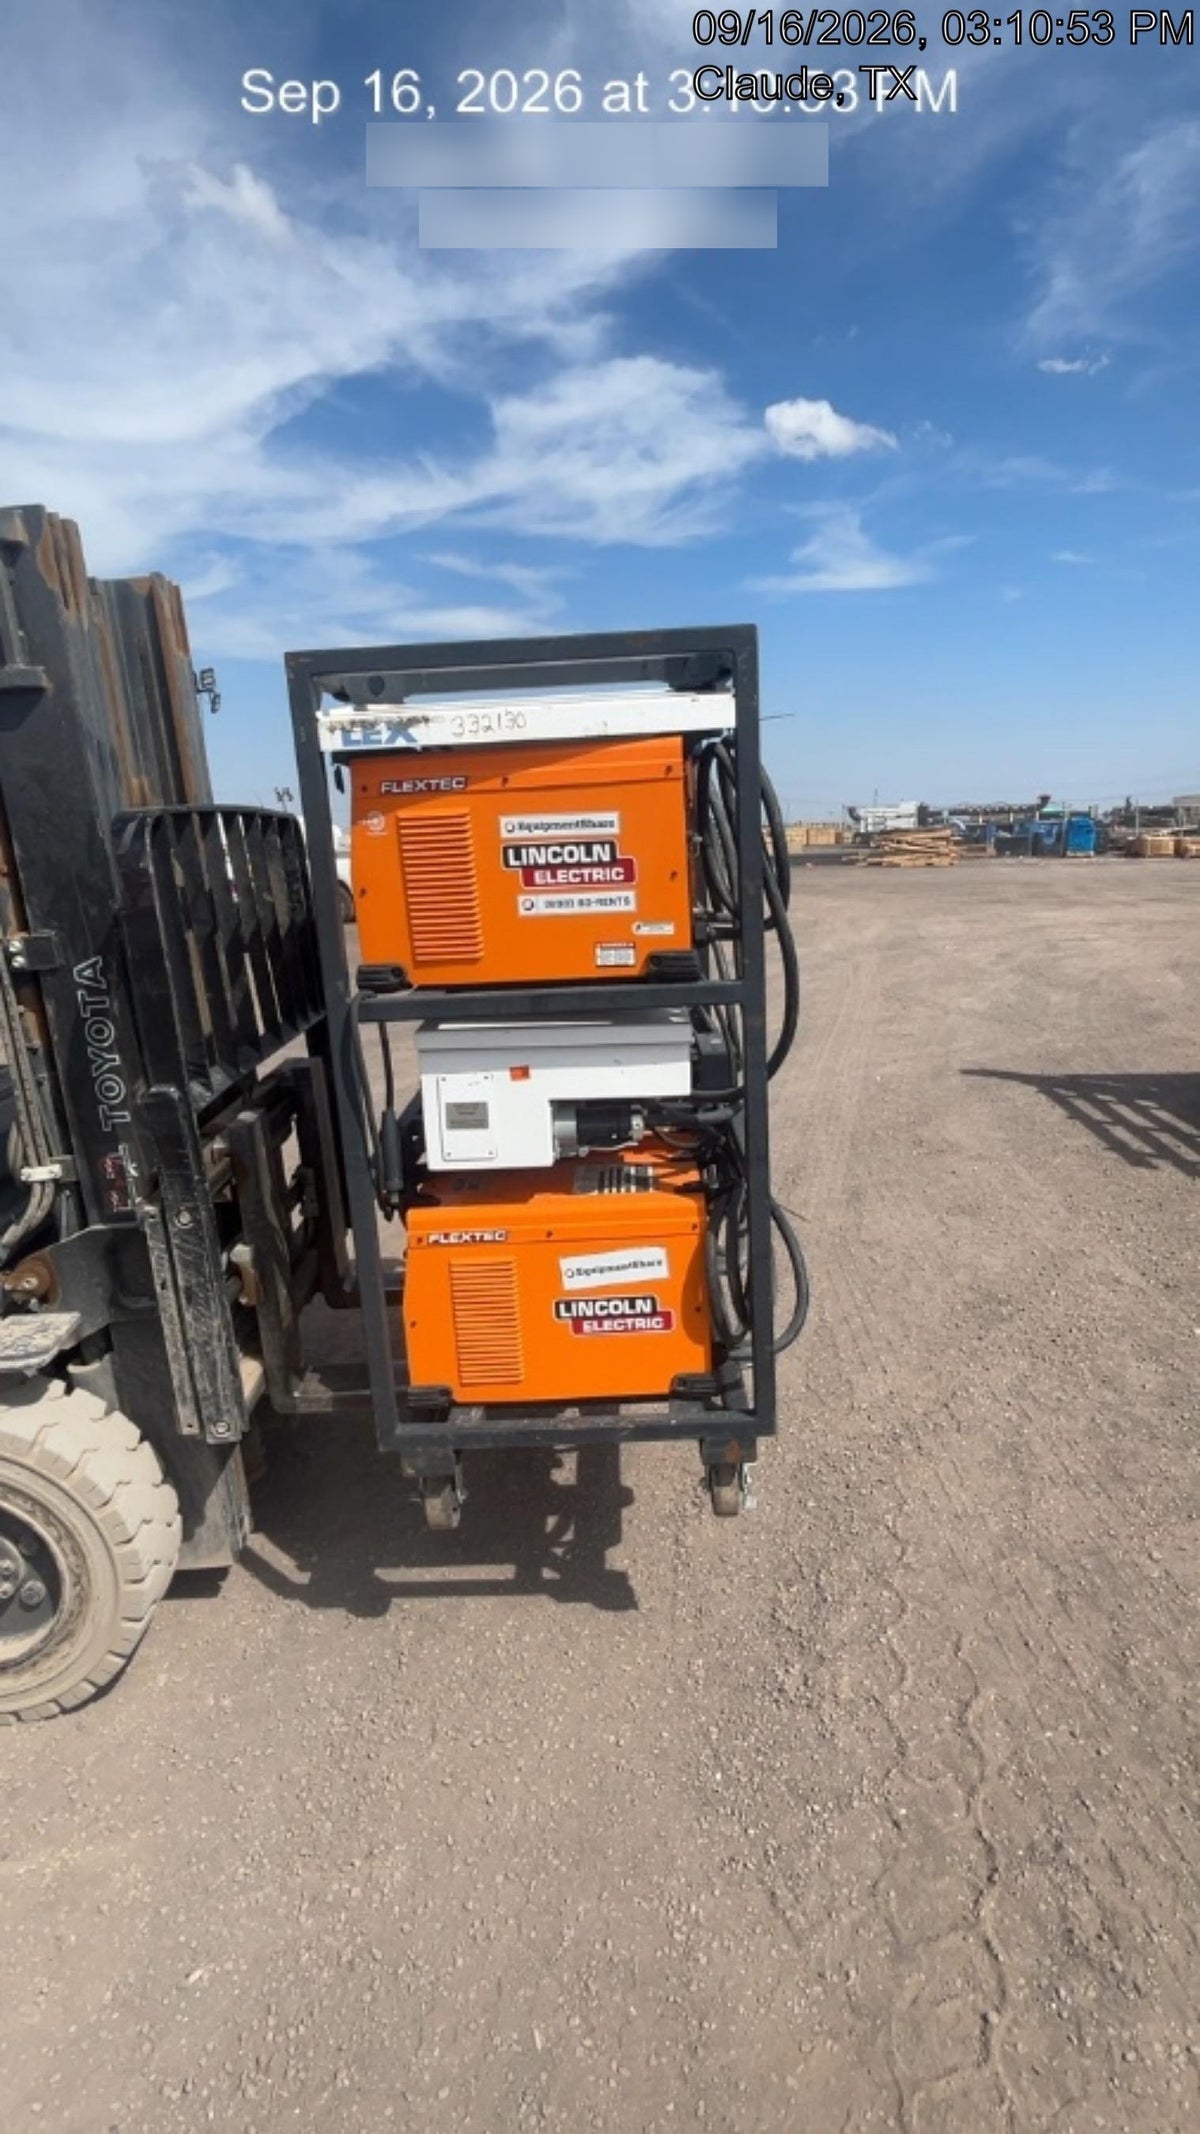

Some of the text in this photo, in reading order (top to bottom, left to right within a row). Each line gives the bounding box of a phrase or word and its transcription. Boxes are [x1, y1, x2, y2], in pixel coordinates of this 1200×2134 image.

[381, 777, 466, 795] FLEXTEC
[507, 843, 612, 867] LINCOLN
[533, 867, 625, 885] ELECTRIC
[73, 955, 131, 1132] TOYOTA
[427, 1230, 507, 1245] FLEXTEC
[558, 1298, 652, 1318] LINCOLN
[582, 1317, 664, 1333] ELECTRIC
